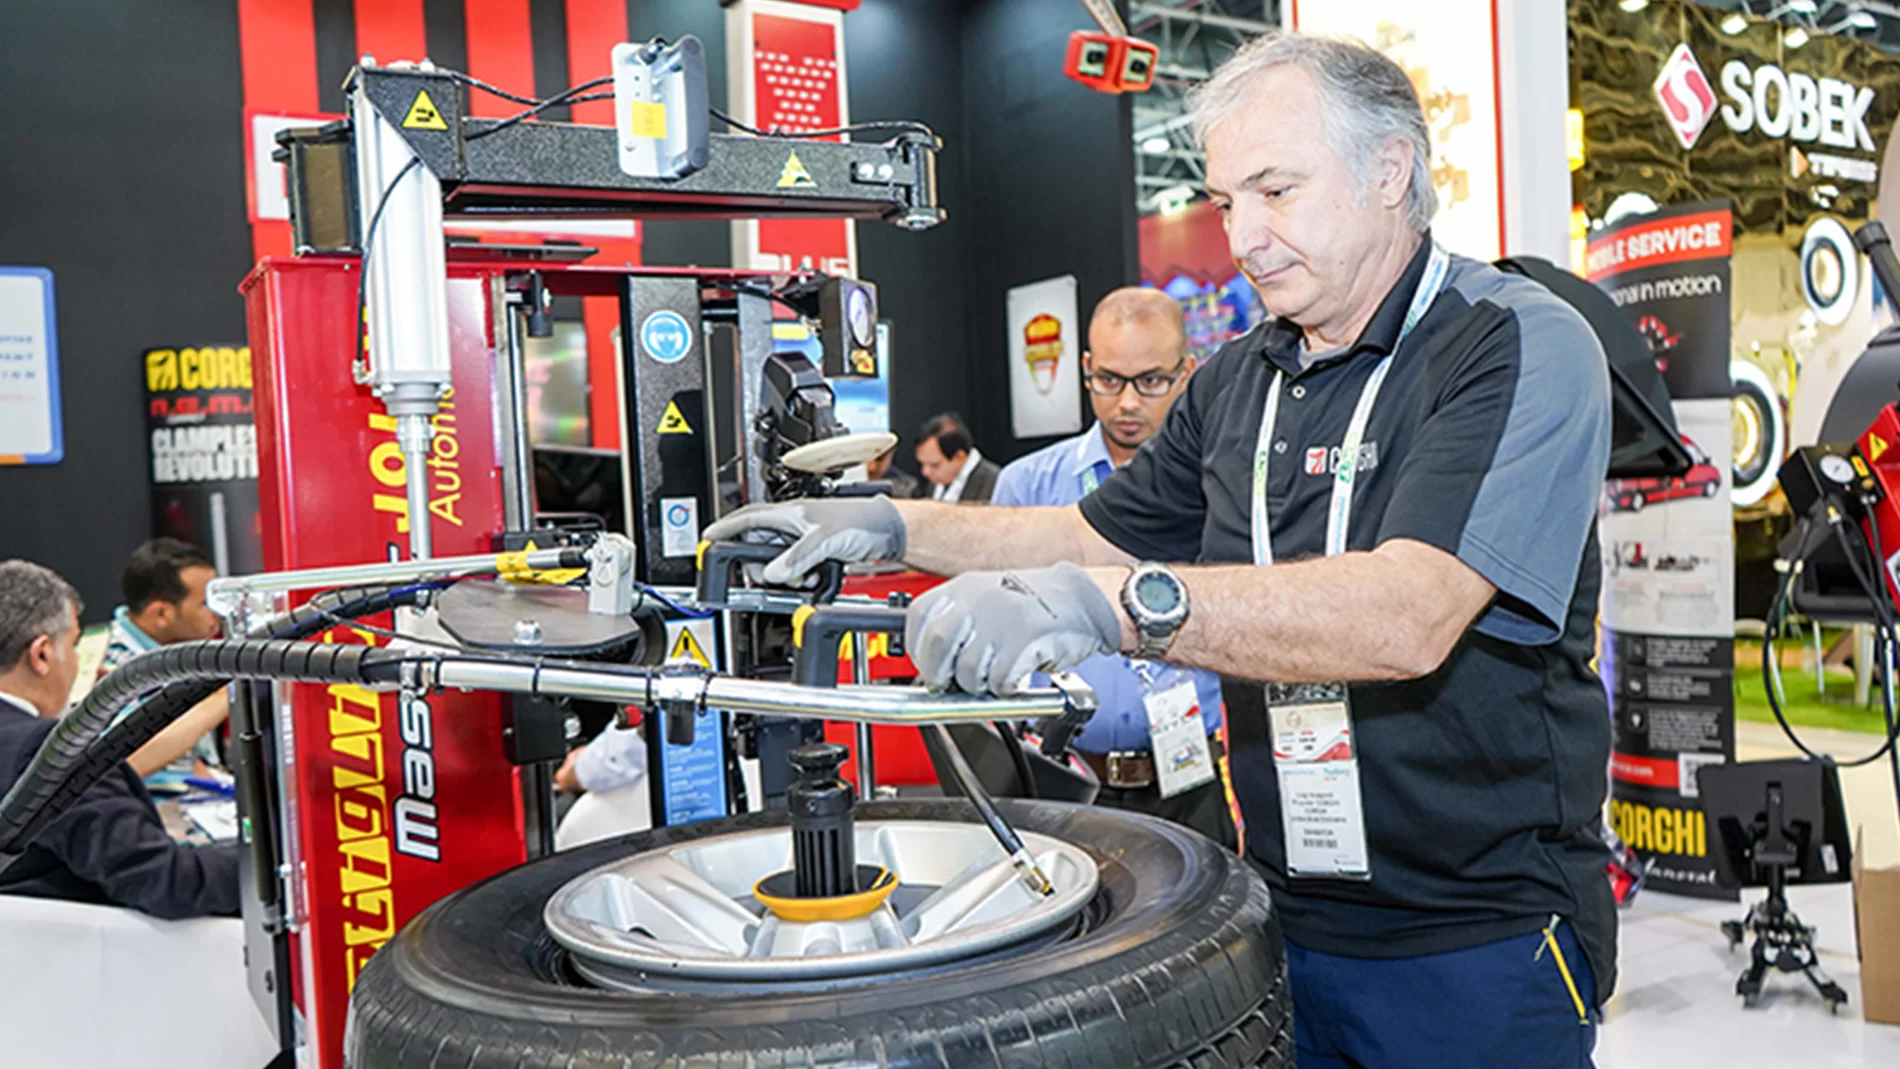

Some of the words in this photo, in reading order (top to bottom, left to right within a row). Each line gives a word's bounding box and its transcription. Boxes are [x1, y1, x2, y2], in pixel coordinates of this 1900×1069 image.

[1720, 60, 1876, 152] SOBEK
[1628, 221, 1721, 259] SERVICE
[1656, 274, 1721, 299] motion
[1610, 799, 1706, 857] CORGHI
